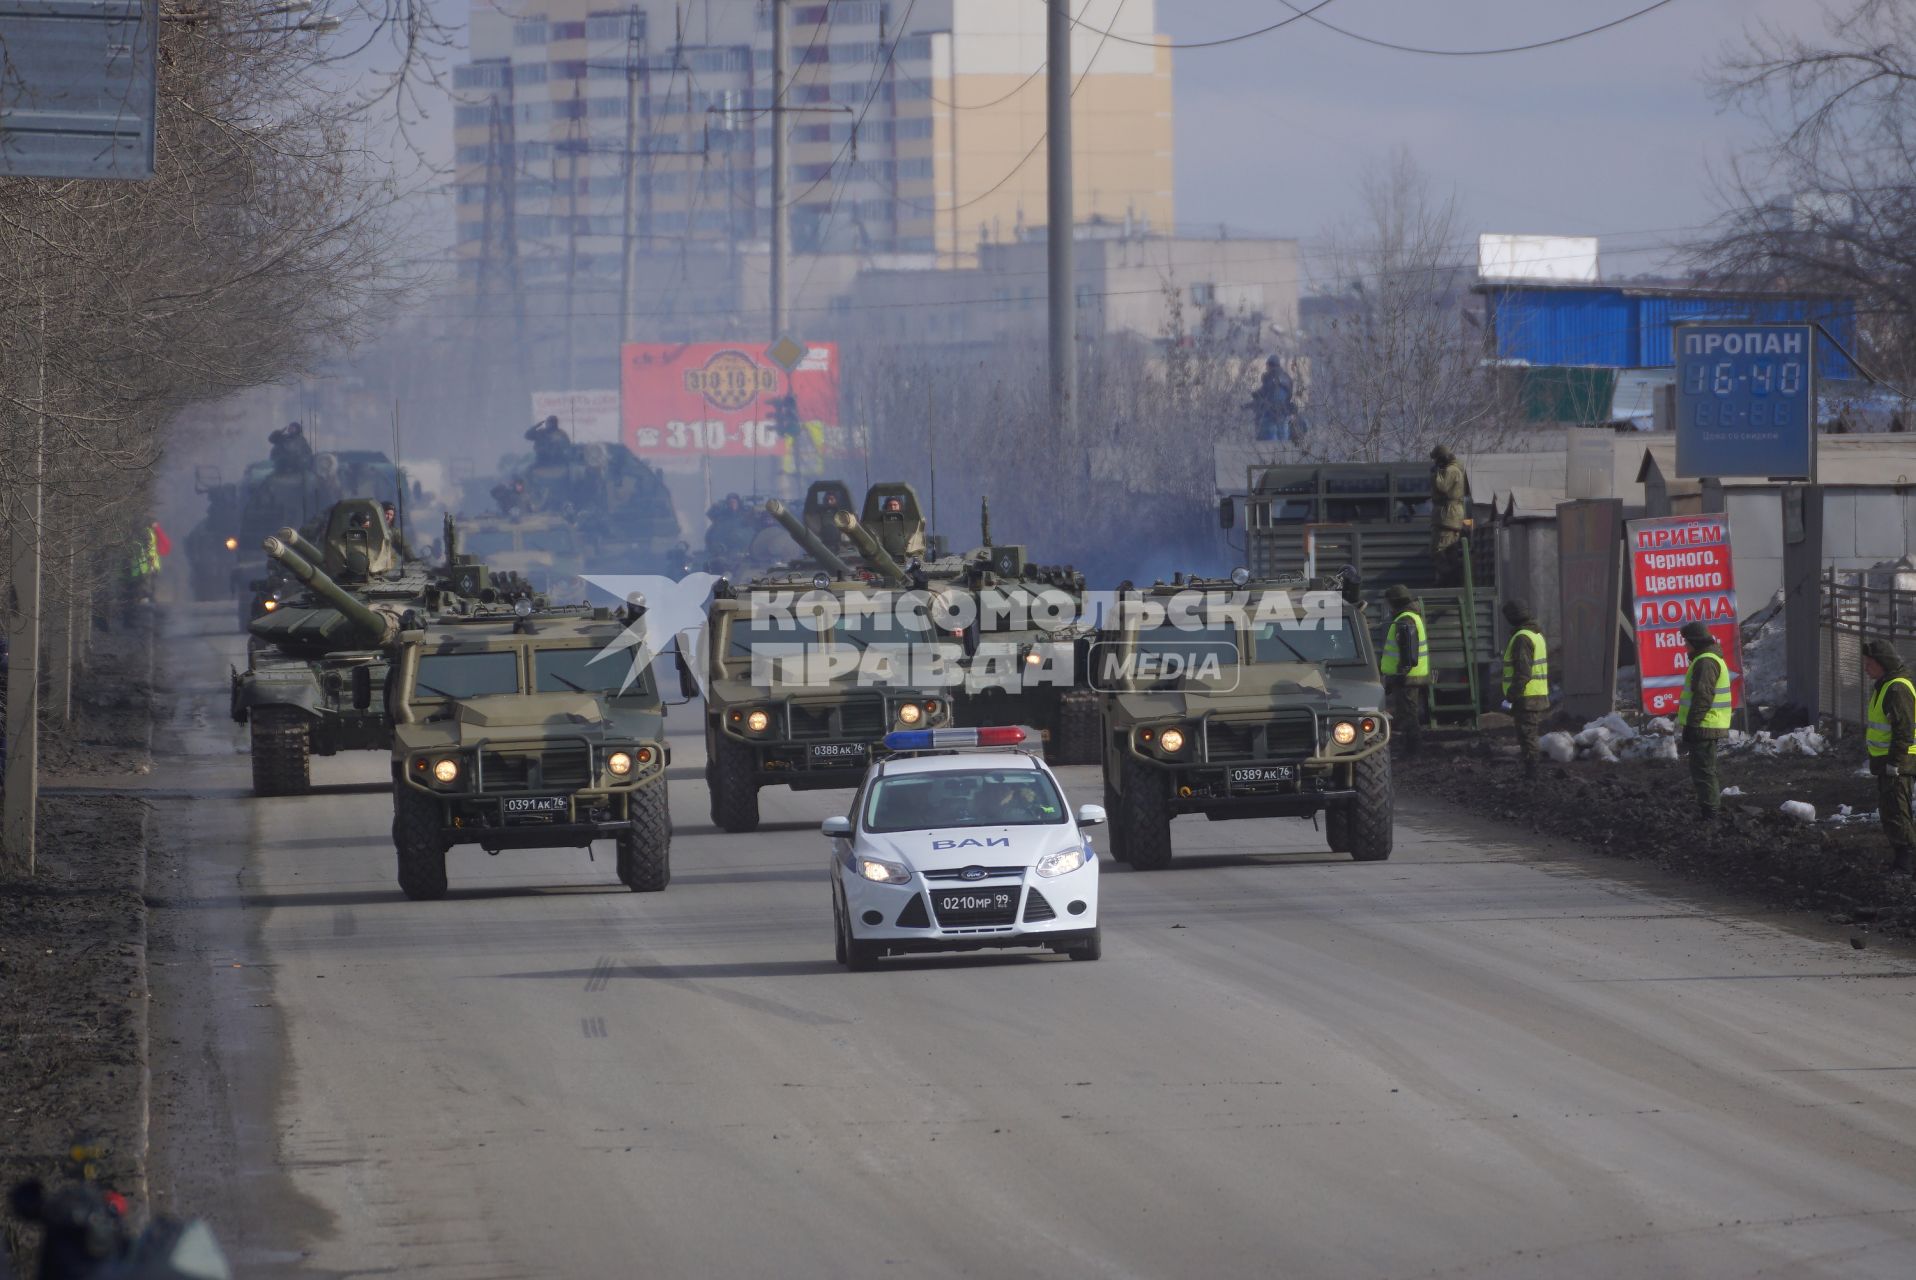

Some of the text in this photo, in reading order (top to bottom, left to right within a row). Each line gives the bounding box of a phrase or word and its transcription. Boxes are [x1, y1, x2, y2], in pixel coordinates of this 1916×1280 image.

[1685, 332, 1802, 354] ПРОПАН
[1638, 521, 1722, 549] ПРИЁМ
[1645, 572, 1722, 593] Цветного
[1637, 596, 1735, 626] ЛОМА
[932, 837, 1010, 850] ВАИ
